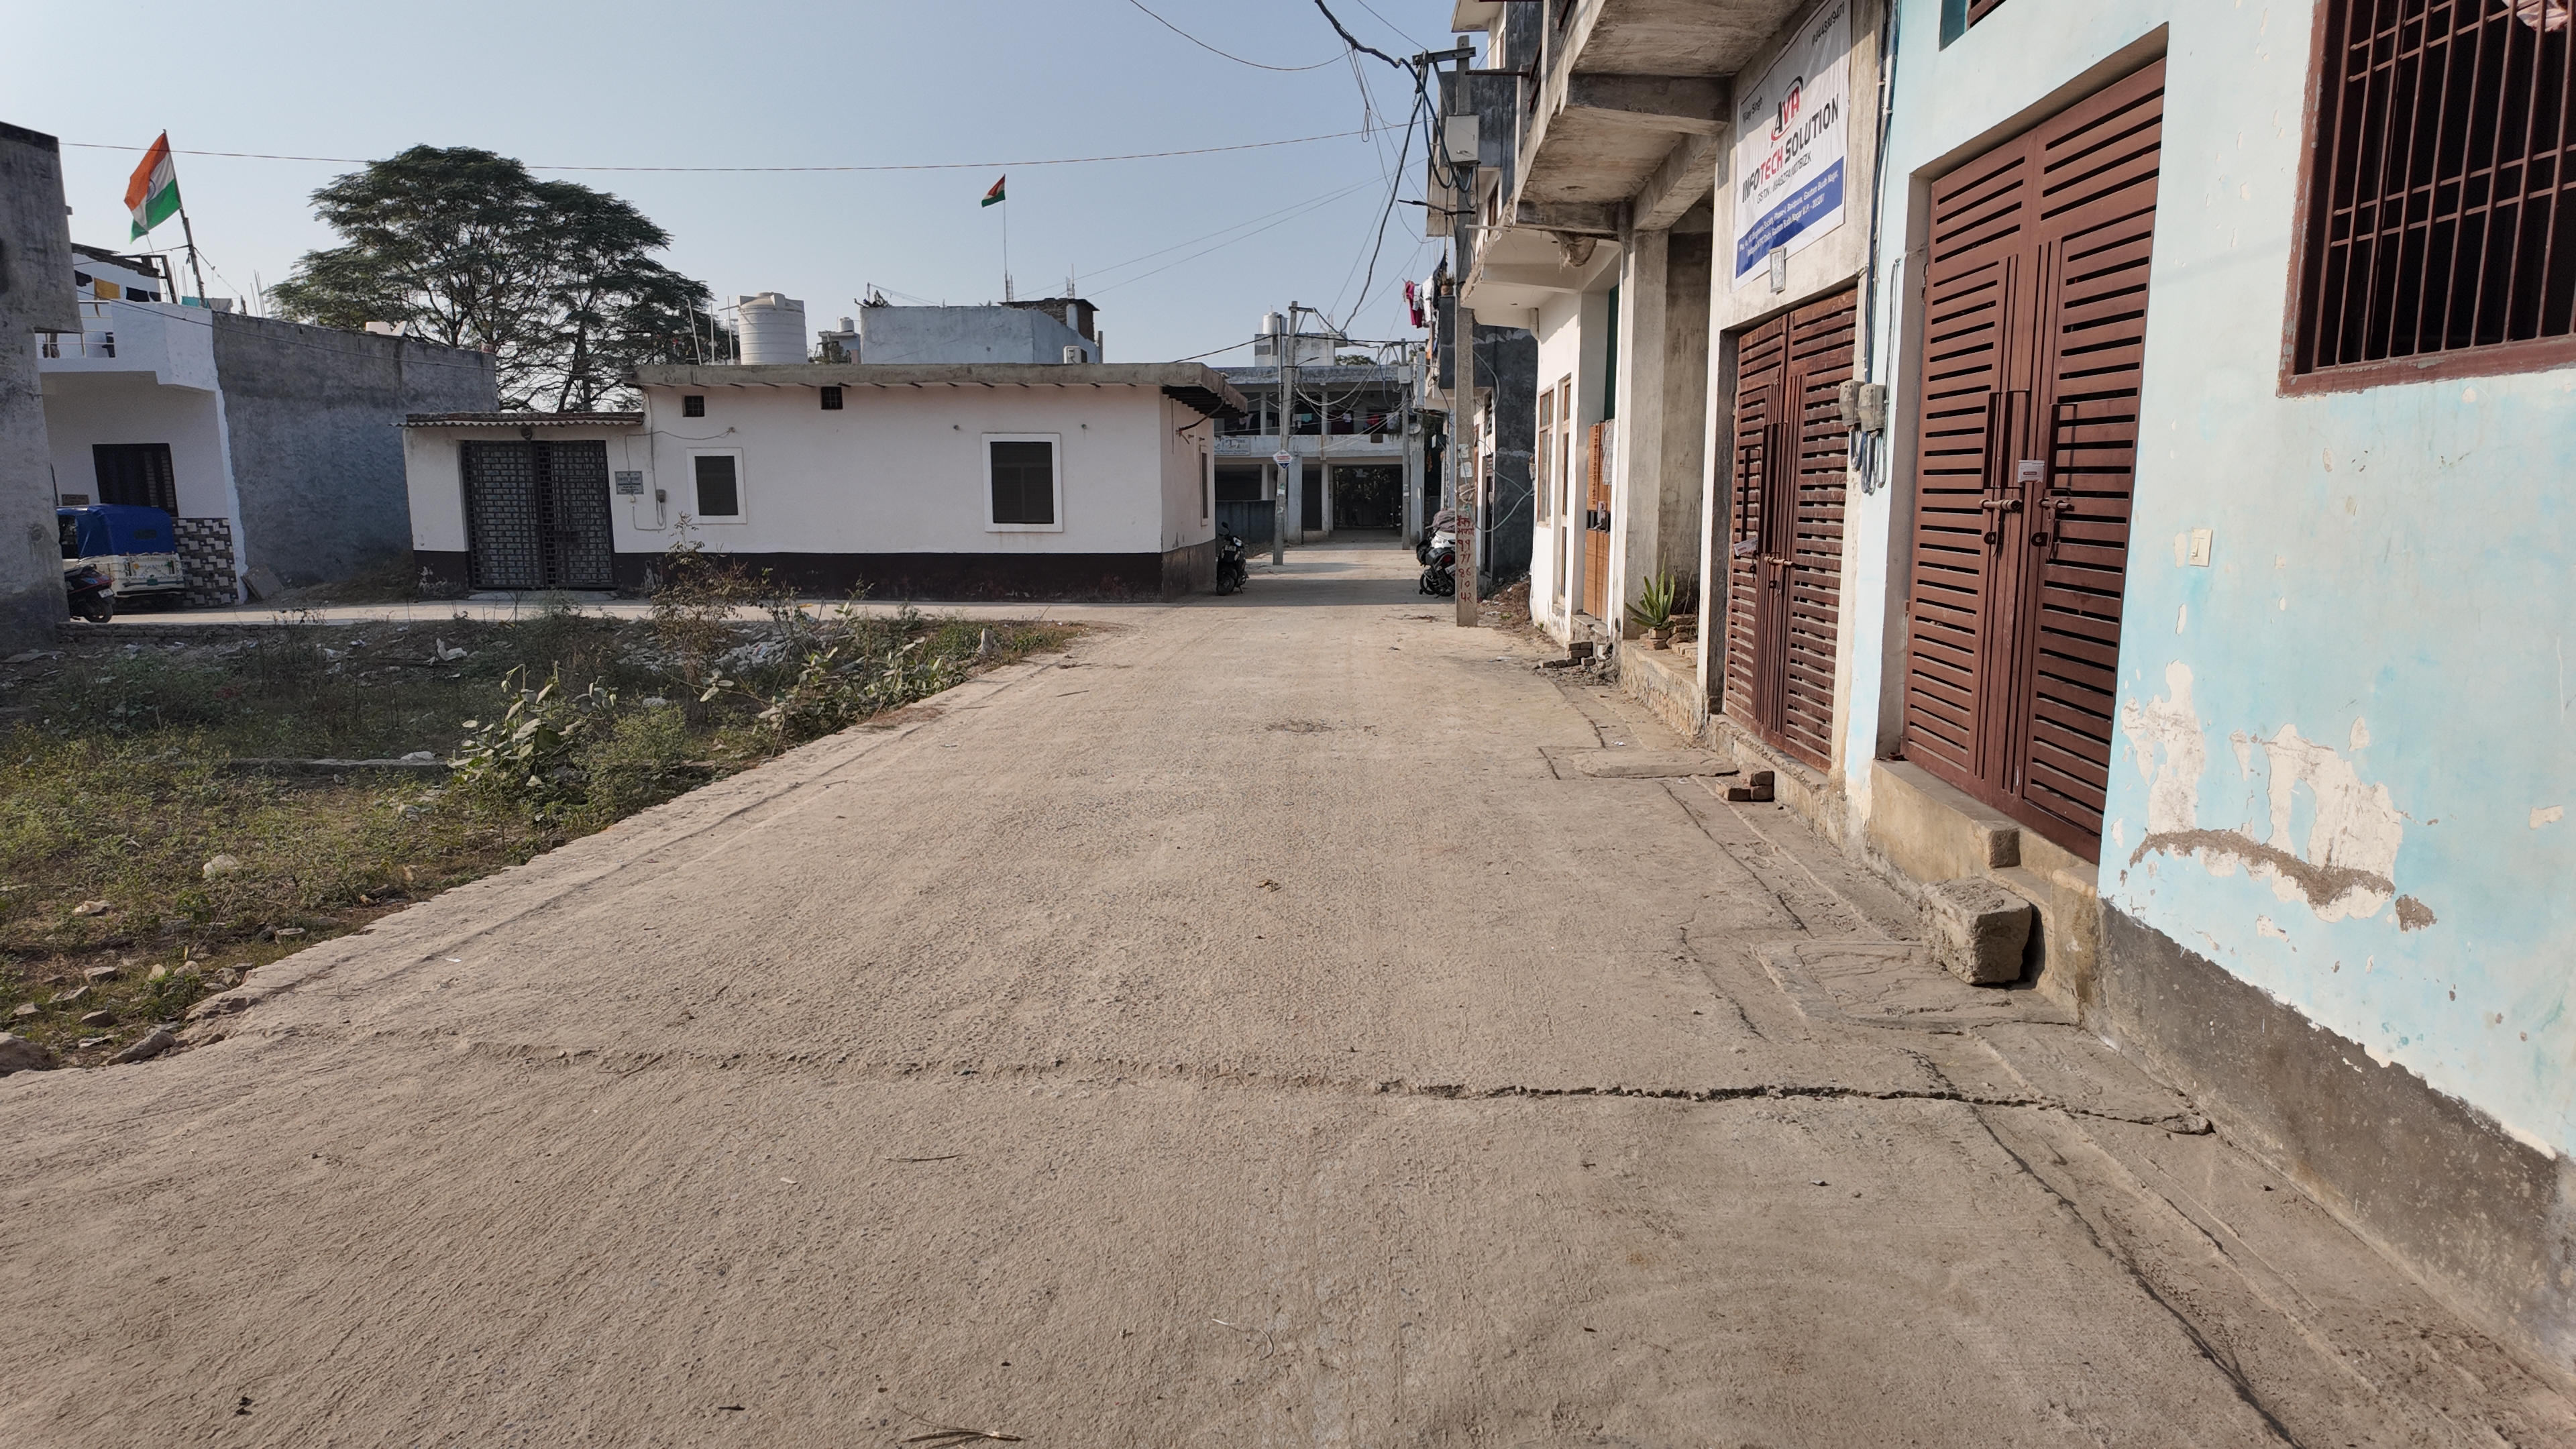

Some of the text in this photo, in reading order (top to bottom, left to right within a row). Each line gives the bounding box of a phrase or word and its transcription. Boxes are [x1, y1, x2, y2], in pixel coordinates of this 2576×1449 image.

[1774, 86, 1800, 135] AVA
[1742, 93, 1839, 203] INFOTECH SOLUTION
[1458, 568, 1471, 578] 86
[1460, 579, 1470, 589] 10
